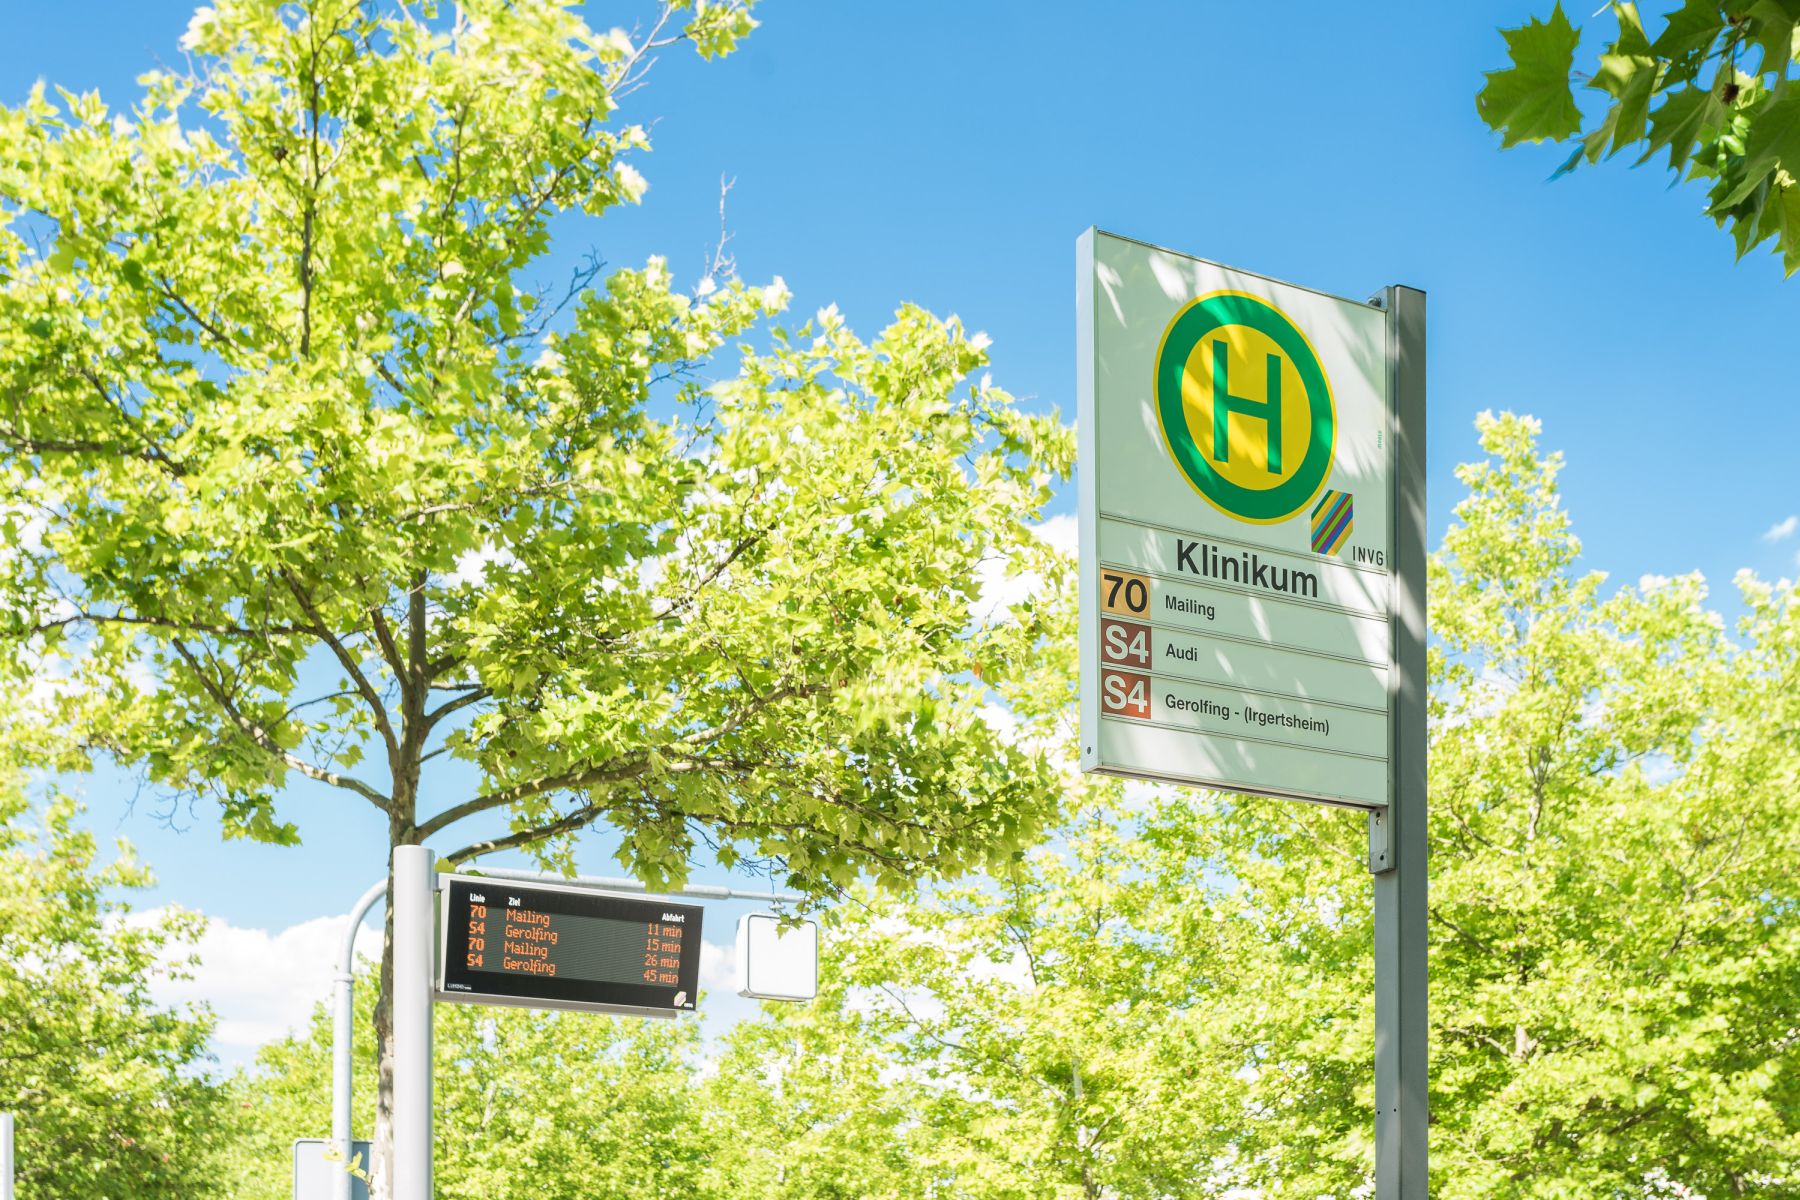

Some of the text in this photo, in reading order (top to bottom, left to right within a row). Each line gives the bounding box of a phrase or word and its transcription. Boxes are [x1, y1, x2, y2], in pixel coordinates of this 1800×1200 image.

[1213, 339, 1282, 475] H
[1177, 538, 1318, 598] Klinikum
[1352, 545, 1384, 567] INVG
[1103, 574, 1215, 620] 70 Mailing
[1105, 624, 1198, 663] S4 Audi
[1103, 674, 1148, 713] S4
[1165, 694, 1230, 721] Gerolfing
[1244, 702, 1330, 736] (Irgertsheim)
[469, 893, 685, 923] Linie Ziel Abfahrt
[470, 905, 683, 938] 70 Mailing 11 min
[468, 921, 681, 954] S4 Gerolfing 15 min
[468, 937, 680, 969] 70 Mailing 26 min
[467, 953, 679, 984] S4 Gerolfing 45 min
